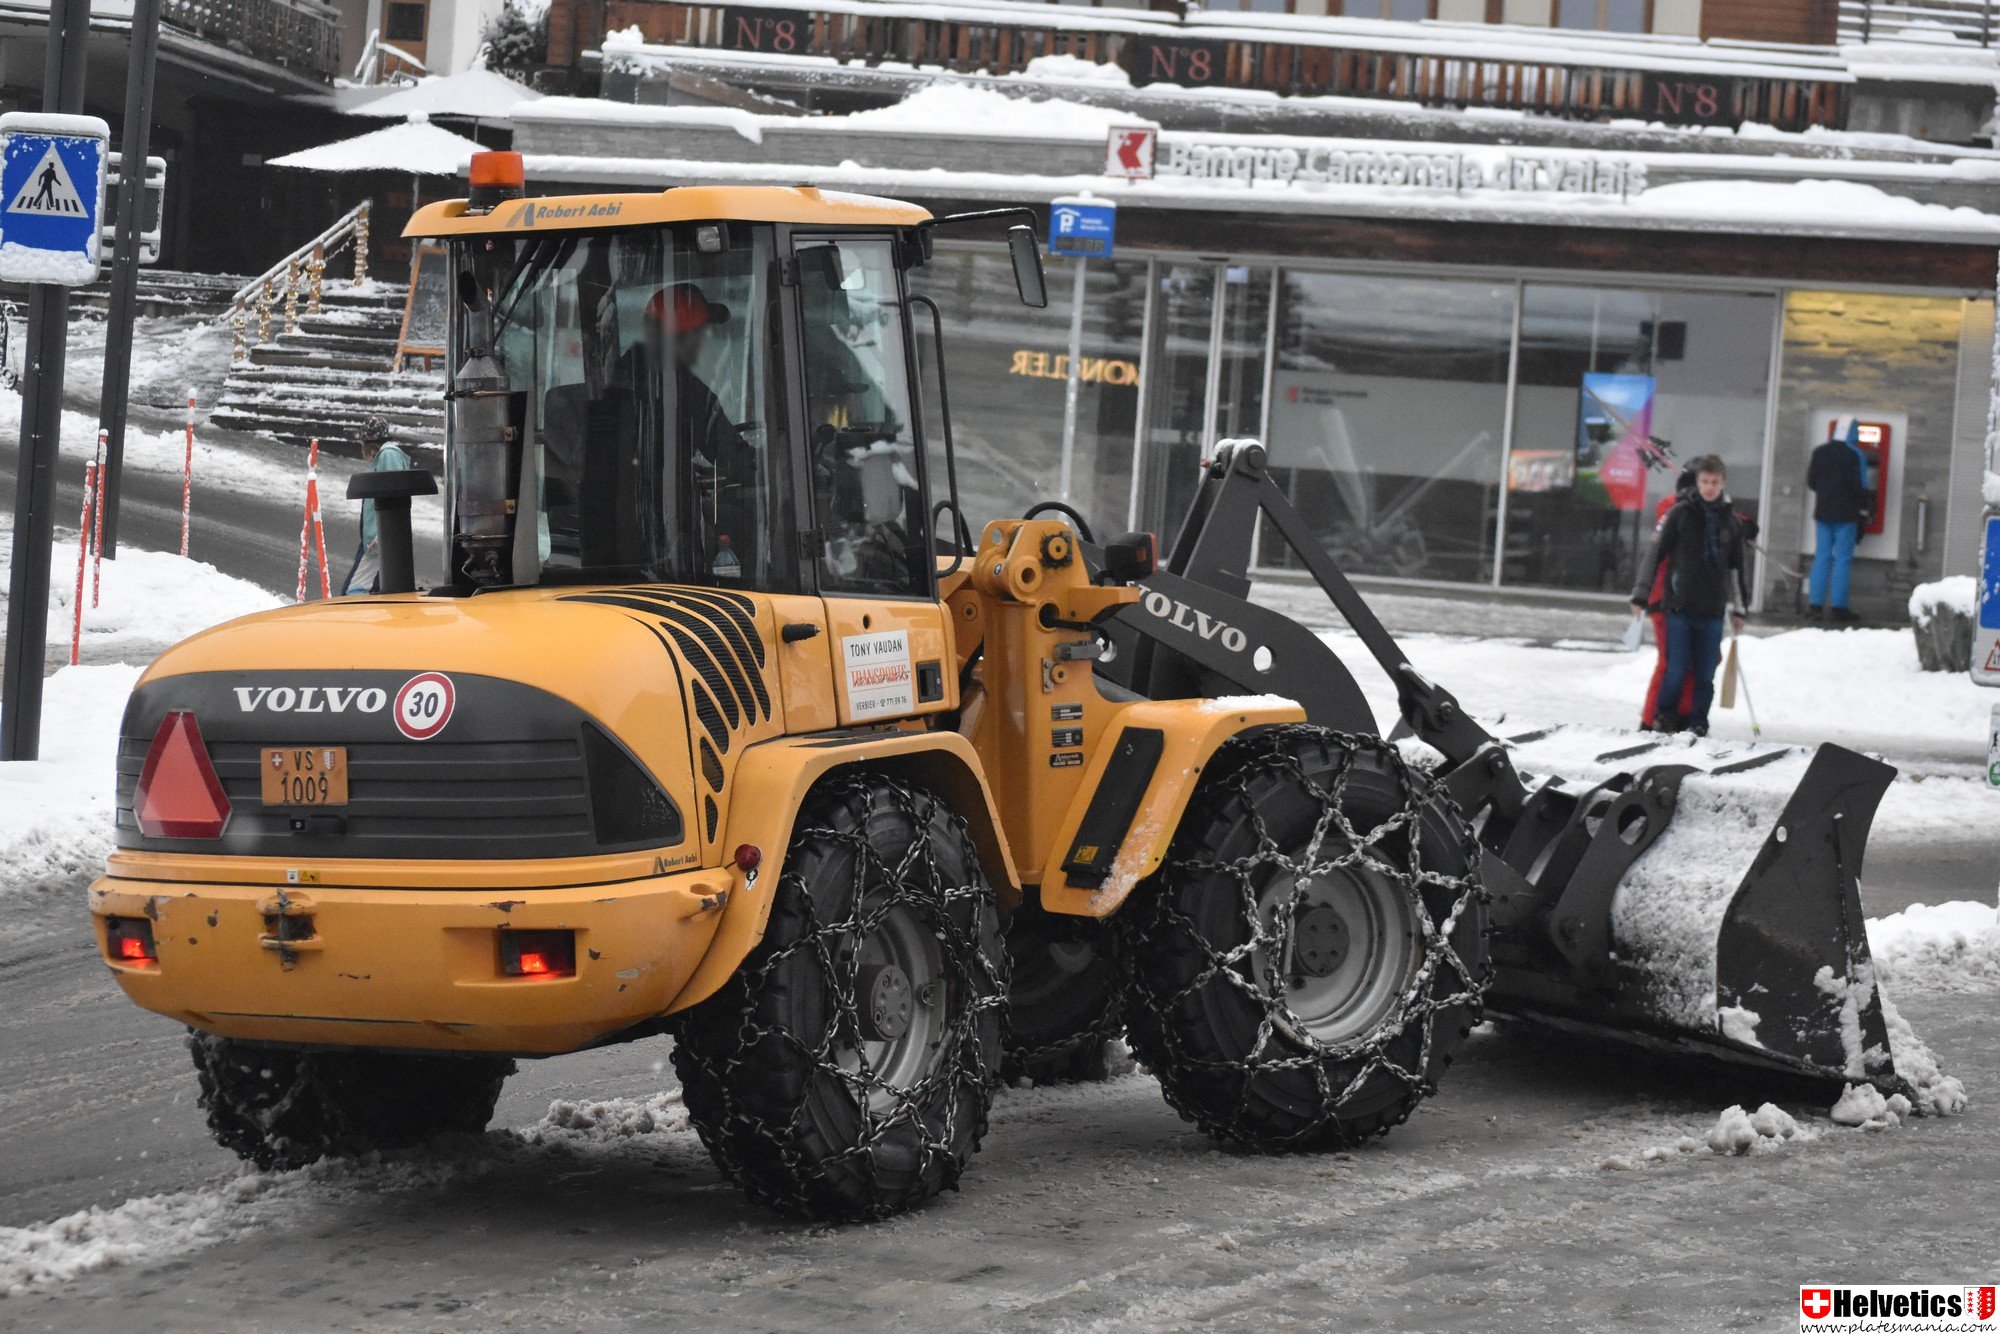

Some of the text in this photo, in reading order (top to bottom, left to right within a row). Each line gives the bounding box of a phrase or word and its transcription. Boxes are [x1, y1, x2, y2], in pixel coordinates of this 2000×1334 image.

[1171, 142, 1298, 186] Banque
[1306, 147, 1483, 190] Cantonale
[1548, 158, 1648, 196] Valais
[536, 202, 623, 219] Robert Aebi
[850, 639, 903, 657] TONY VAUDAN
[233, 687, 387, 713] VOLVO
[409, 691, 439, 718] 30
[856, 700, 876, 711] VERBIER
[293, 750, 313, 771] VS
[280, 776, 328, 803] 1009
